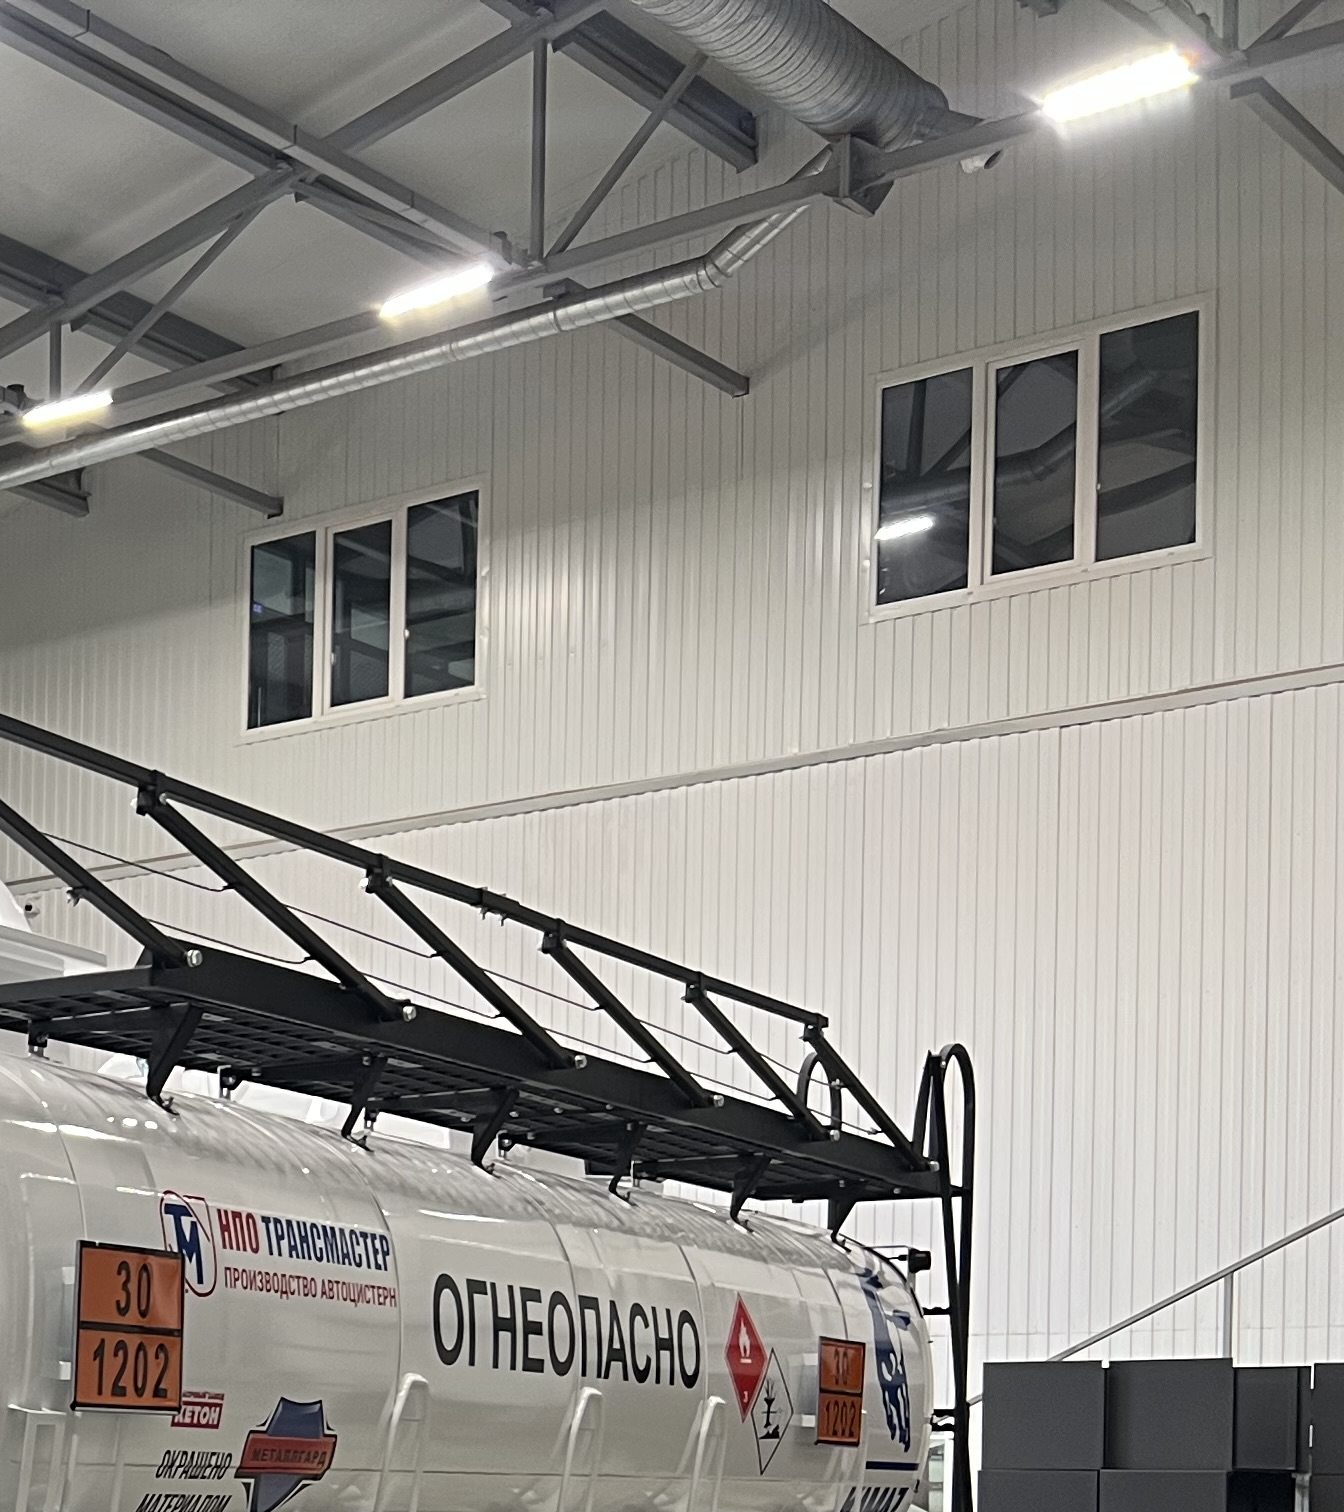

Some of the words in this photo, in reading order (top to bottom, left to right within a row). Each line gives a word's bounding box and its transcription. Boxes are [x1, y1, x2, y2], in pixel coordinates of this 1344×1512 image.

[216, 1208, 260, 1254] НПО
[260, 1215, 390, 1272] ТРАНСМАСТЕР
[115, 1260, 152, 1319] 30
[224, 1266, 316, 1300] ПРОИЗВОДСТВО
[320, 1278, 397, 1308] АВТОЦИСТЕРН
[433, 1272, 700, 1390] ОГНЕОПАСНО
[92, 1338, 170, 1399] 1202
[824, 1400, 857, 1438] 1202
[155, 1449, 233, 1480] ОКРАШЕНО
